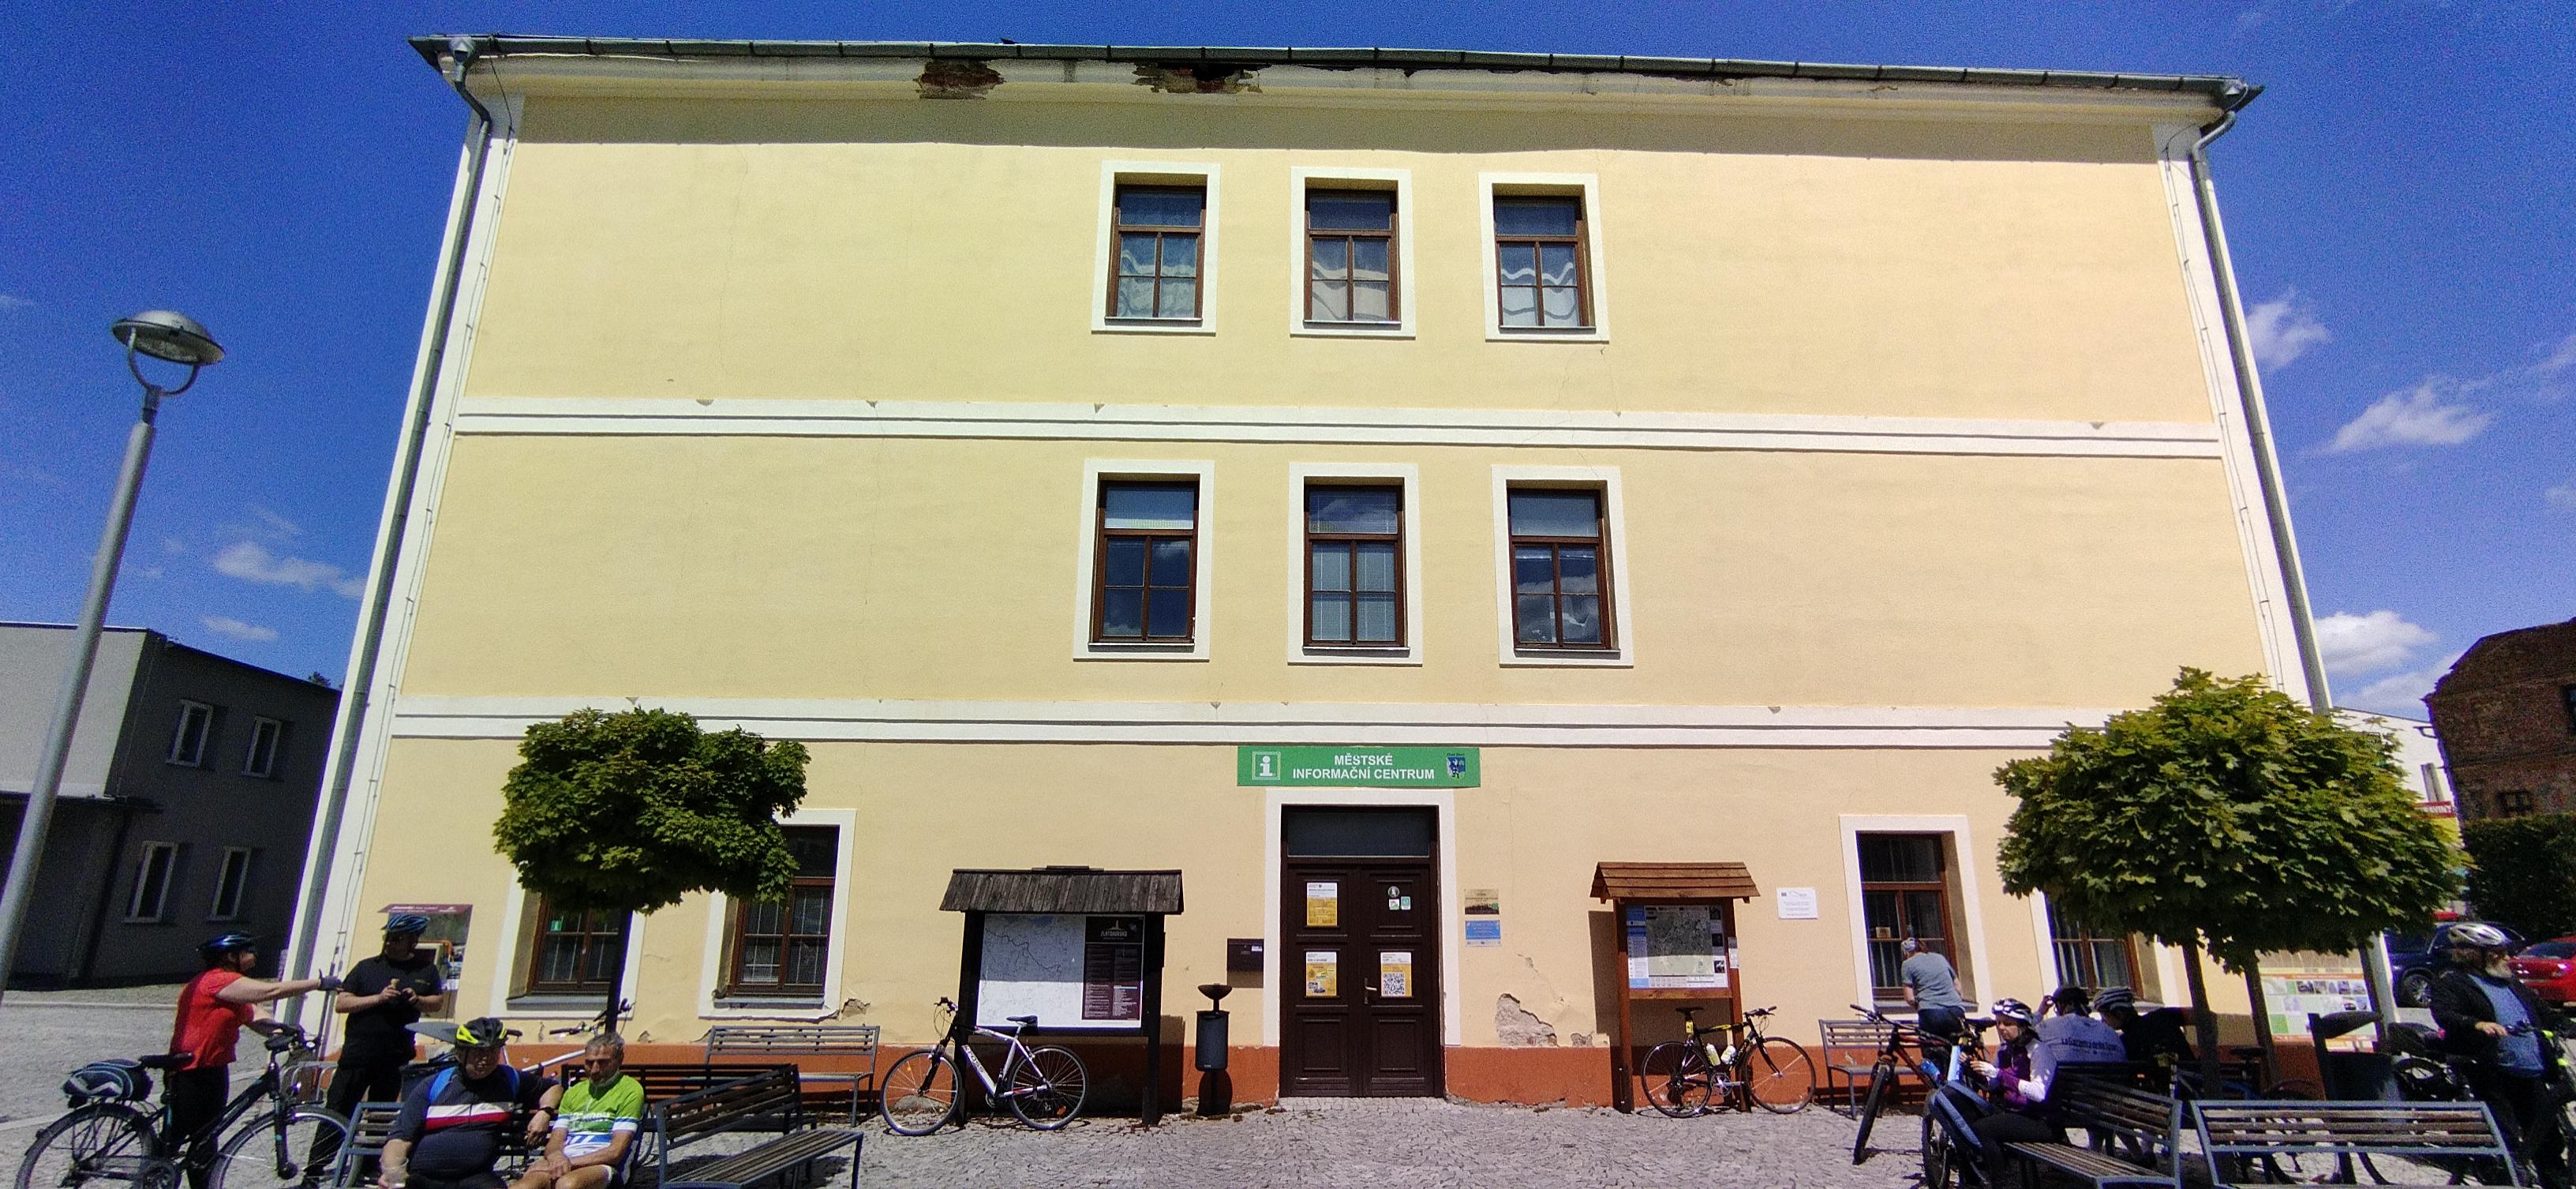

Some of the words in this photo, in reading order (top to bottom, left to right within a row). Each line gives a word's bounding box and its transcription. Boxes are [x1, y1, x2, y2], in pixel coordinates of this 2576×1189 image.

[1334, 753, 1393, 766] MĚSTSKÉ
[1293, 767, 1371, 779] INFORMAČNÍ
[1374, 768, 1435, 779] CENTRUM
